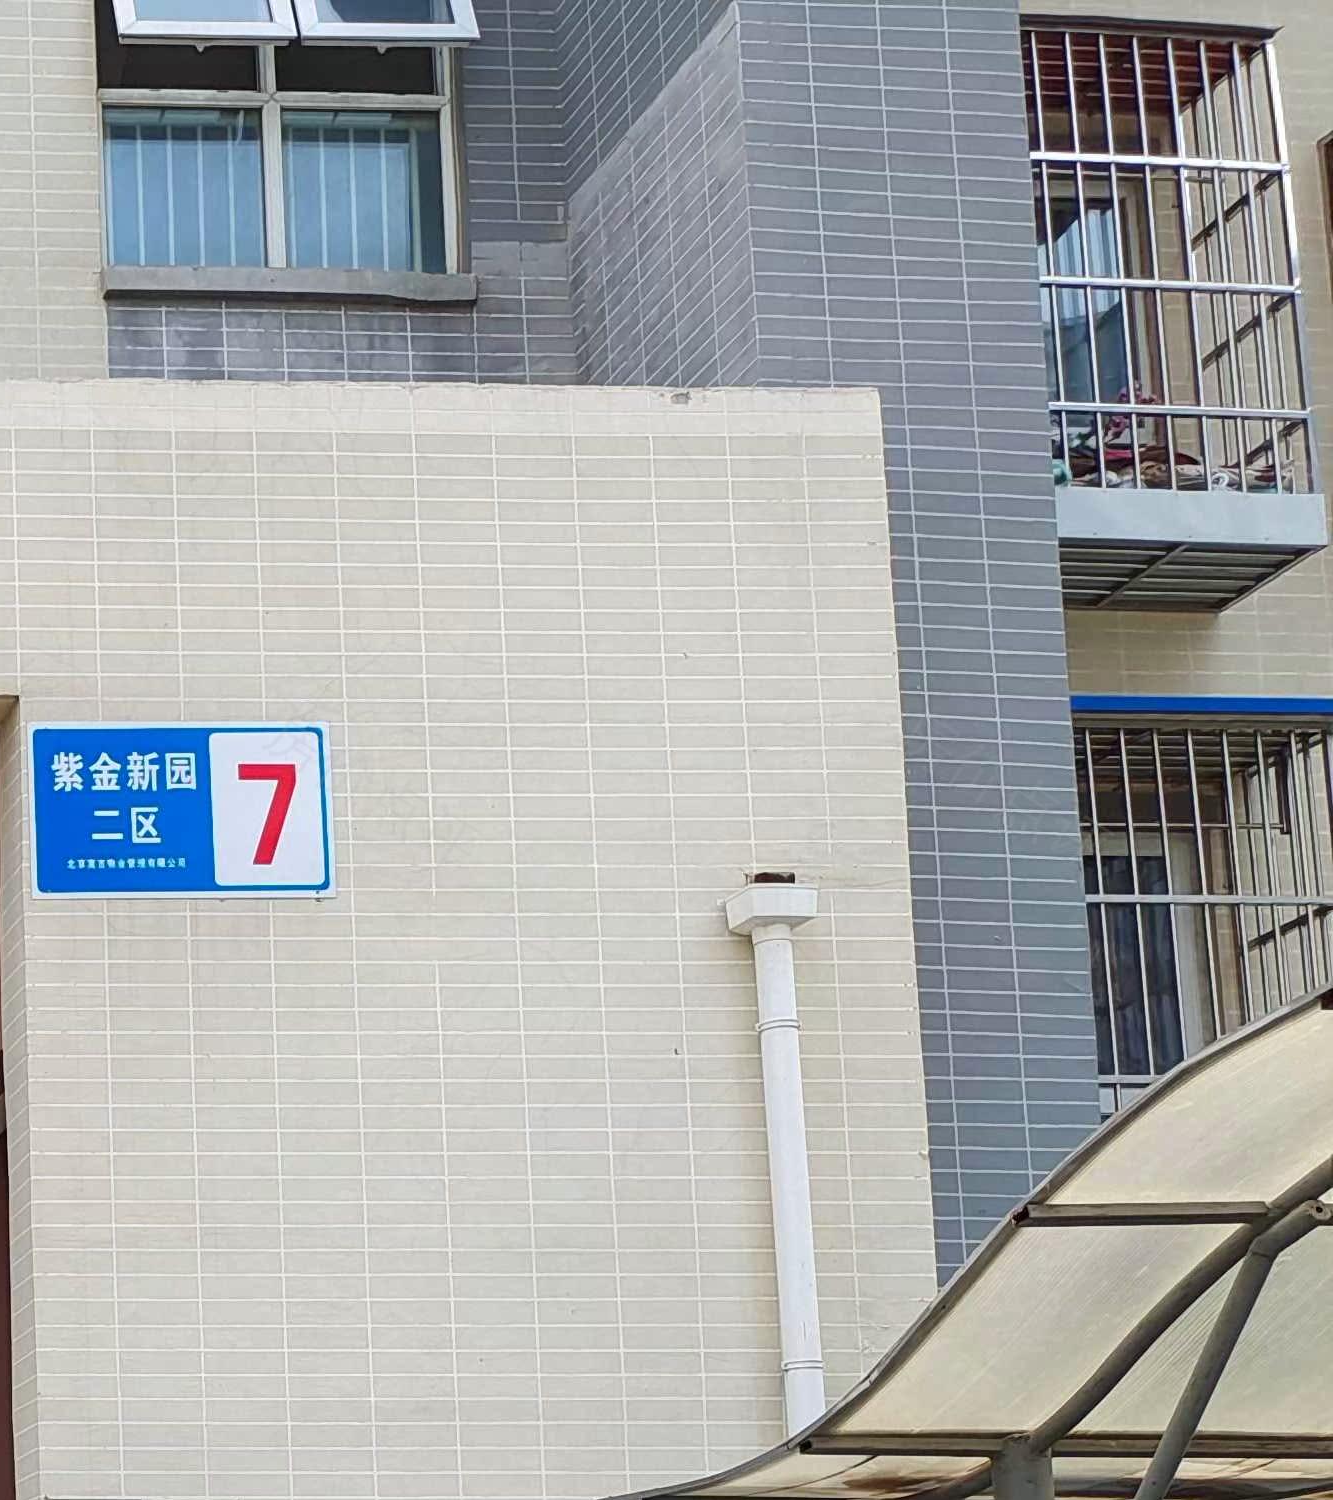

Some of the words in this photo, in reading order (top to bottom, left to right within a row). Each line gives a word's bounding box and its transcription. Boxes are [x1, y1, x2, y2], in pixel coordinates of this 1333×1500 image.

[51, 752, 197, 792] 紫金新园
[91, 807, 161, 843] 二区
[237, 763, 297, 865] 7
